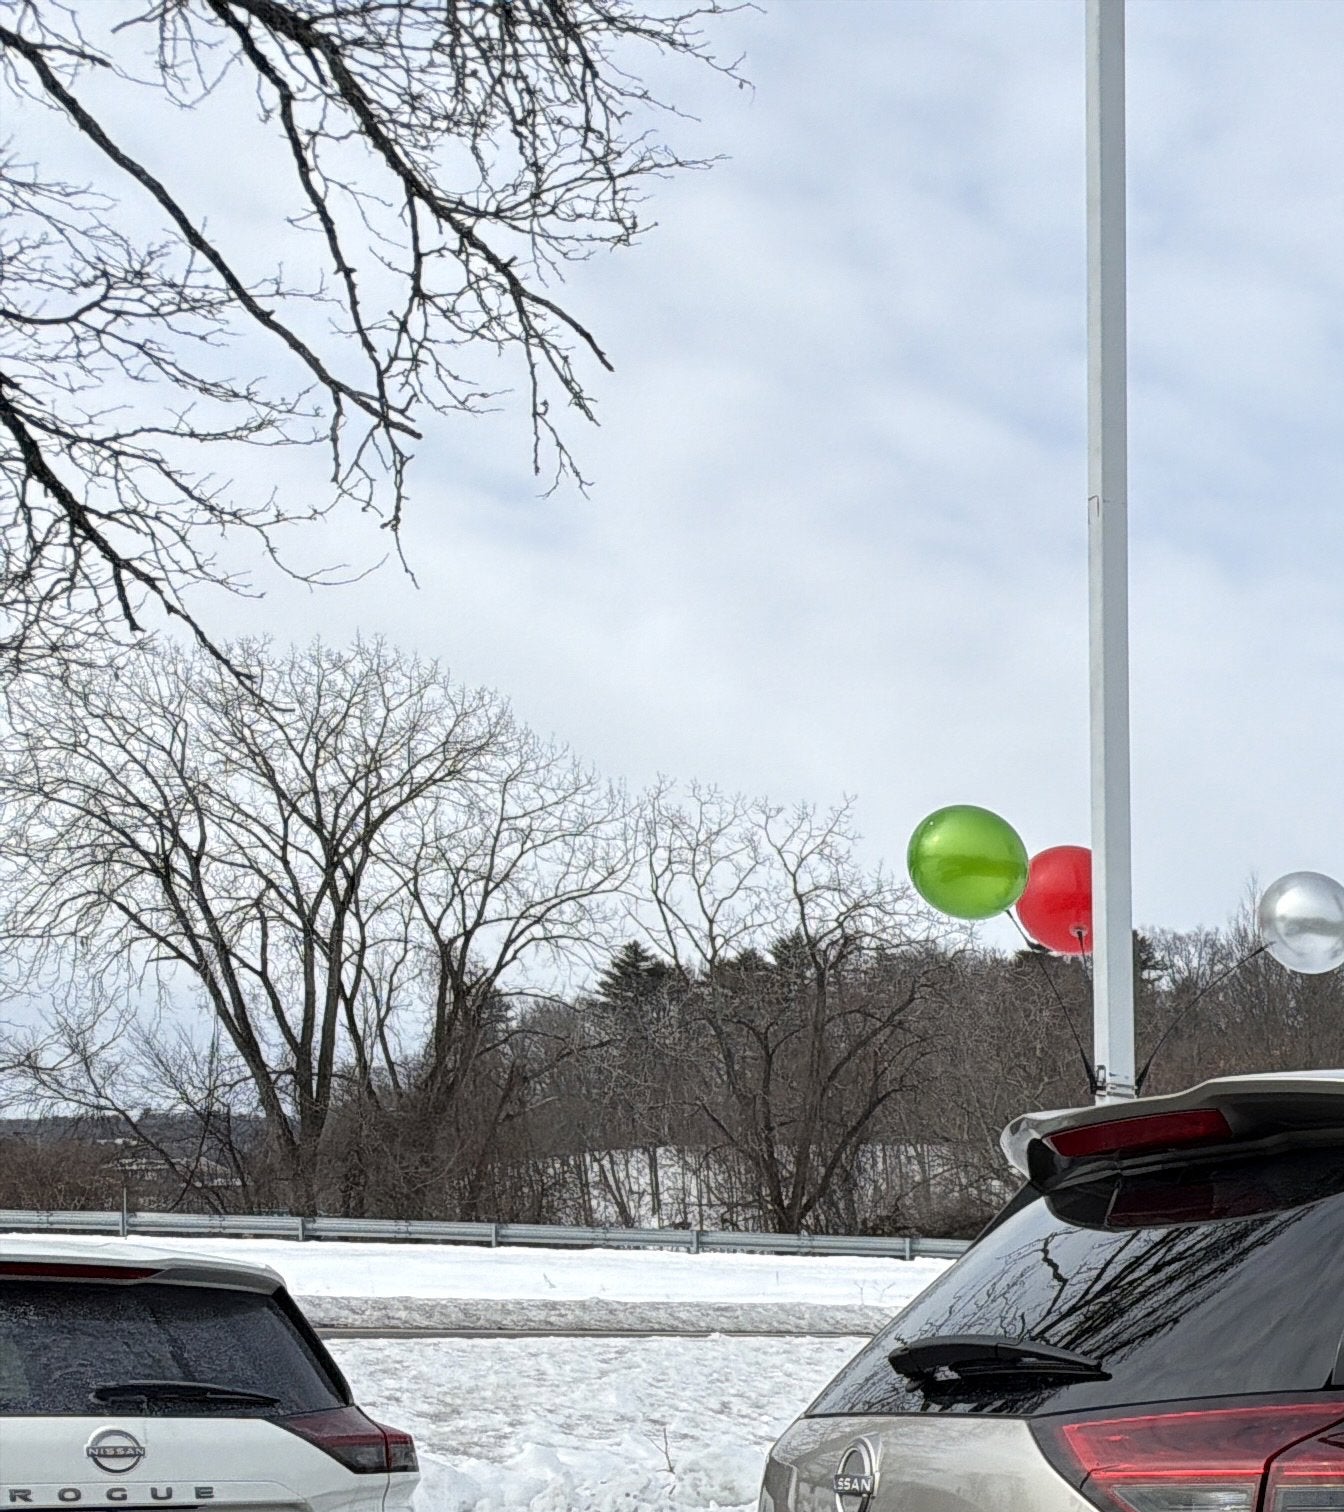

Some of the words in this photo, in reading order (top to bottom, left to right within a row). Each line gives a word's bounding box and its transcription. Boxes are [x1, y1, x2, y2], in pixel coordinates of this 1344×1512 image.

[87, 1447, 145, 1456] NISSAN
[832, 1477, 872, 1492] ISSAN
[8, 1485, 215, 1503] ROGUE
